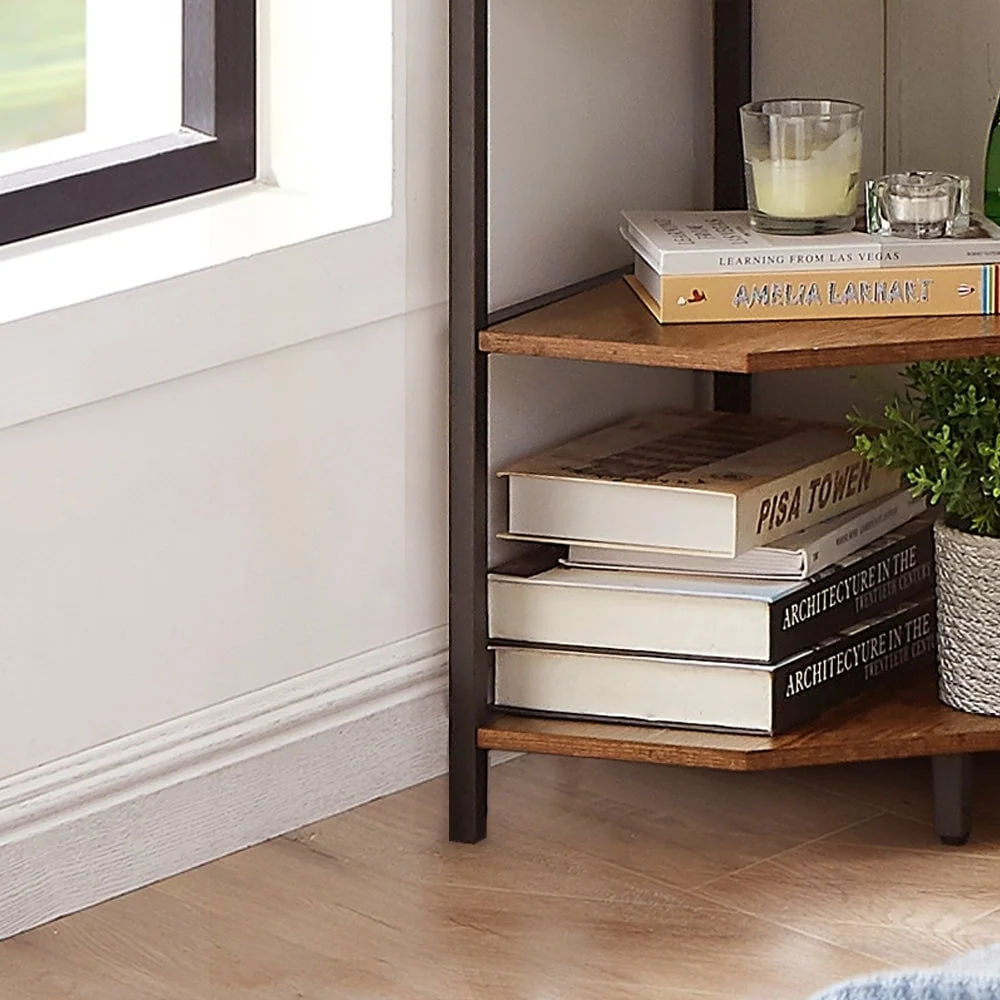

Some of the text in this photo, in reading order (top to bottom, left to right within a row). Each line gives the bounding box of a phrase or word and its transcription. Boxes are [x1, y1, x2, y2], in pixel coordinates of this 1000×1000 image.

[719, 251, 900, 266] LEARNING FROM LAS VEGAS
[732, 281, 823, 310] AMELIA
[756, 486, 801, 535] PISA
[878, 558, 891, 584] IN
[892, 545, 917, 576] THE
[889, 627, 902, 651] IN
[906, 613, 930, 643] THE
